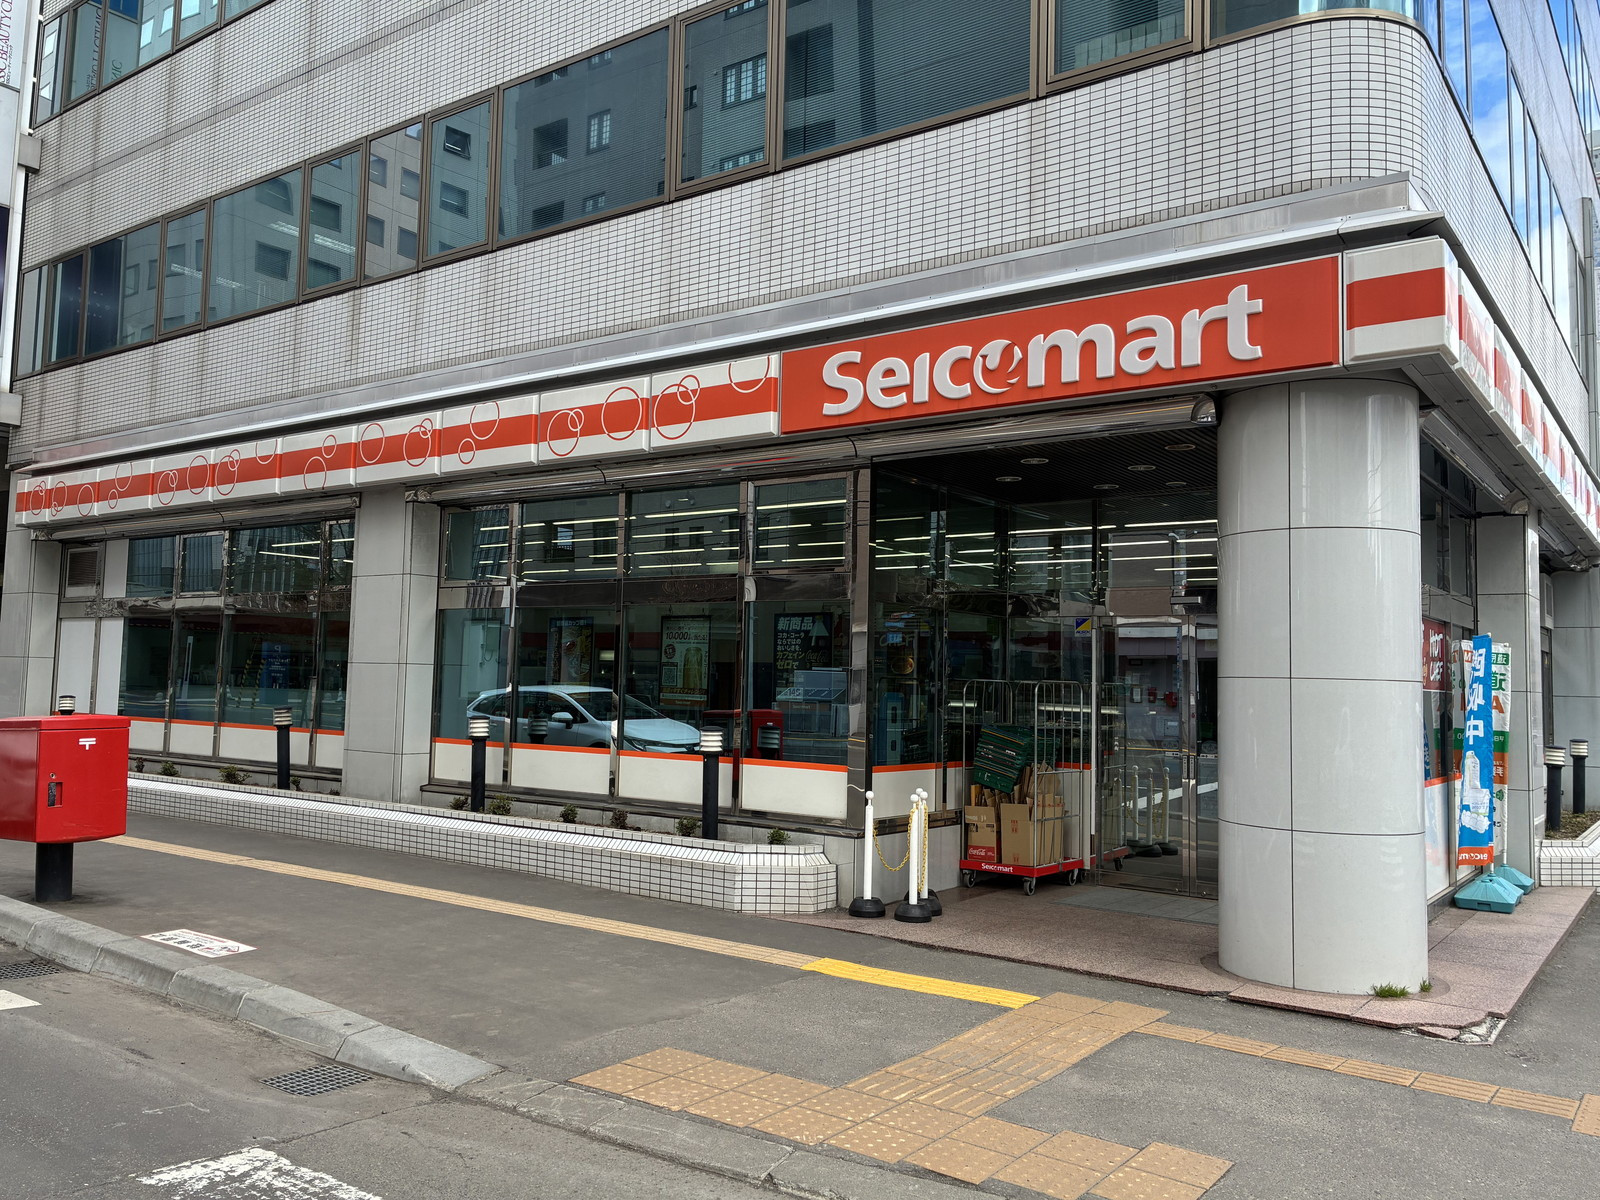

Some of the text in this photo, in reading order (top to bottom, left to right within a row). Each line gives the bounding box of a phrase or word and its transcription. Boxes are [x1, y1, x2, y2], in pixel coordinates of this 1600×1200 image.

[822, 284, 1263, 416] Seicomart
[777, 616, 813, 631] 新商品
[776, 651, 805, 659] カフェイン
[776, 660, 799, 669] ゼロで
[981, 863, 1014, 873] Seicomart
